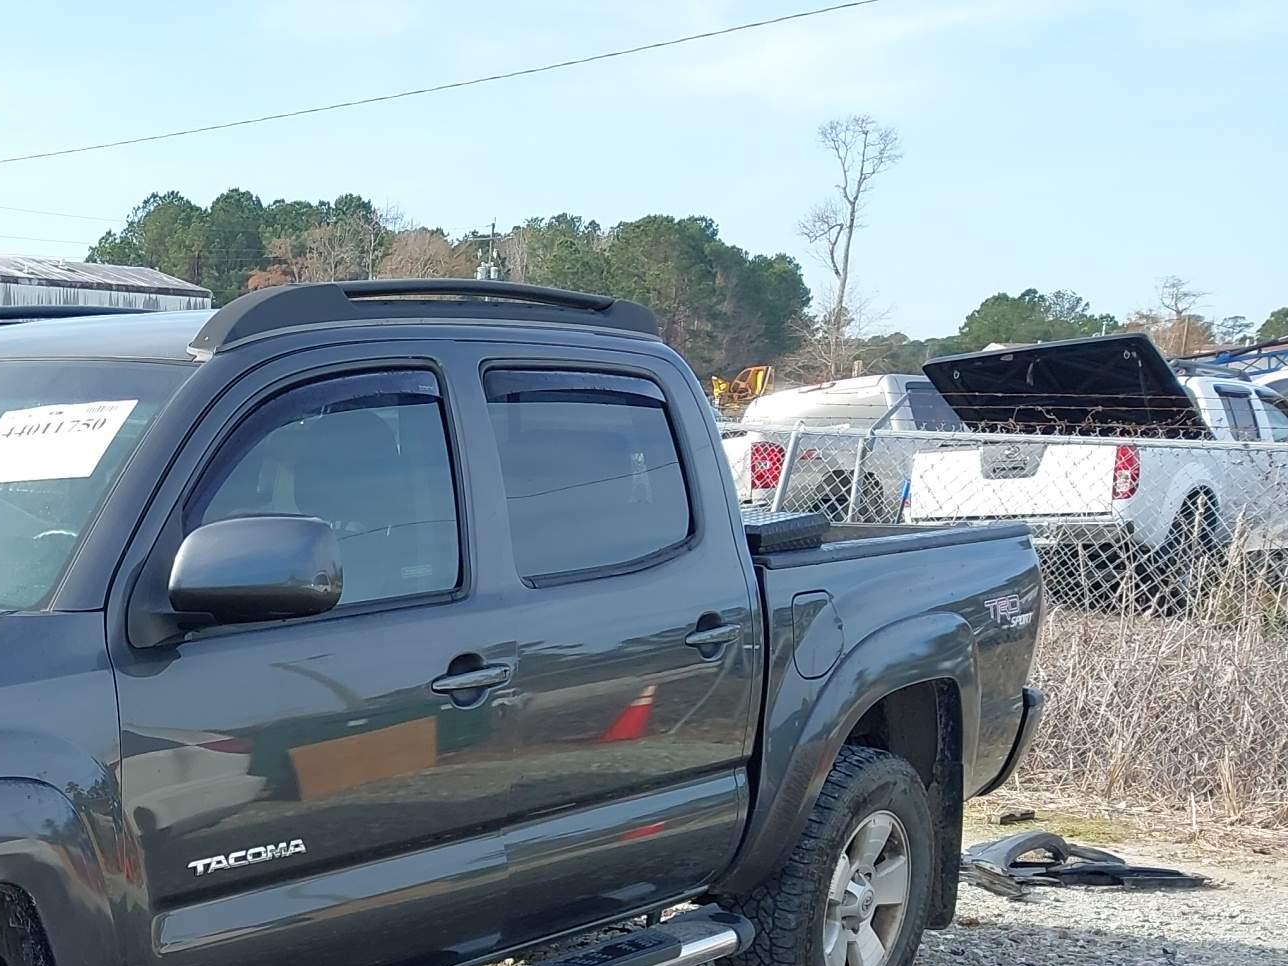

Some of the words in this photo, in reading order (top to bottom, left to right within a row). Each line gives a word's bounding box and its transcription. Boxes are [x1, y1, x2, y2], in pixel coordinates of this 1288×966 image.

[2, 418, 107, 438] 44011750
[984, 594, 1020, 624] TRD
[1010, 612, 1033, 628] SPORT
[187, 838, 307, 876] TACOMA
